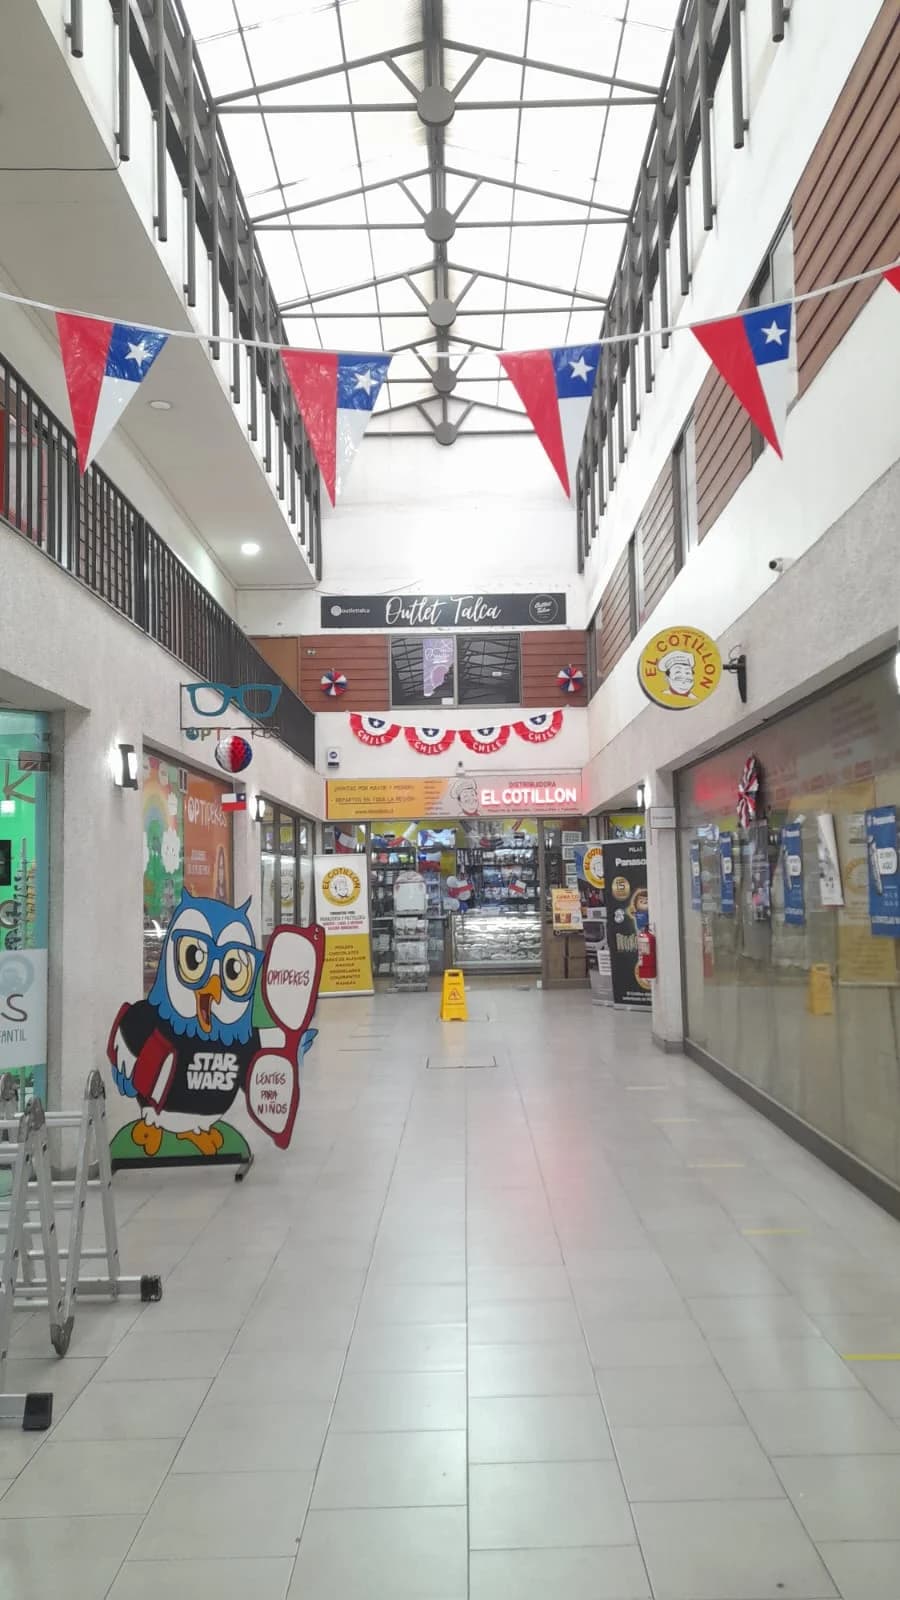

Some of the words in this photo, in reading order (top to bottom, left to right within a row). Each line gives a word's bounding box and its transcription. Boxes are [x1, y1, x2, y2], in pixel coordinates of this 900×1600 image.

[386, 596, 447, 626] Outlet
[450, 596, 502, 625] Talca
[645, 658, 658, 677] EL
[656, 634, 716, 689] COTILLON
[357, 731, 386, 745] CHILE
[528, 729, 556, 743] CHILE
[414, 742, 444, 755] CHILE
[472, 741, 502, 753] CHILE
[481, 789, 500, 805] EL
[502, 788, 577, 804] COTILLON
[267, 969, 310, 987] OPTIPEKES
[188, 1052, 239, 1071] STAR
[187, 1071, 237, 1090] WARS
[256, 1072, 286, 1085] LENTES
[261, 1090, 278, 1101] PARA
[257, 1101, 287, 1115] NIÑOS
